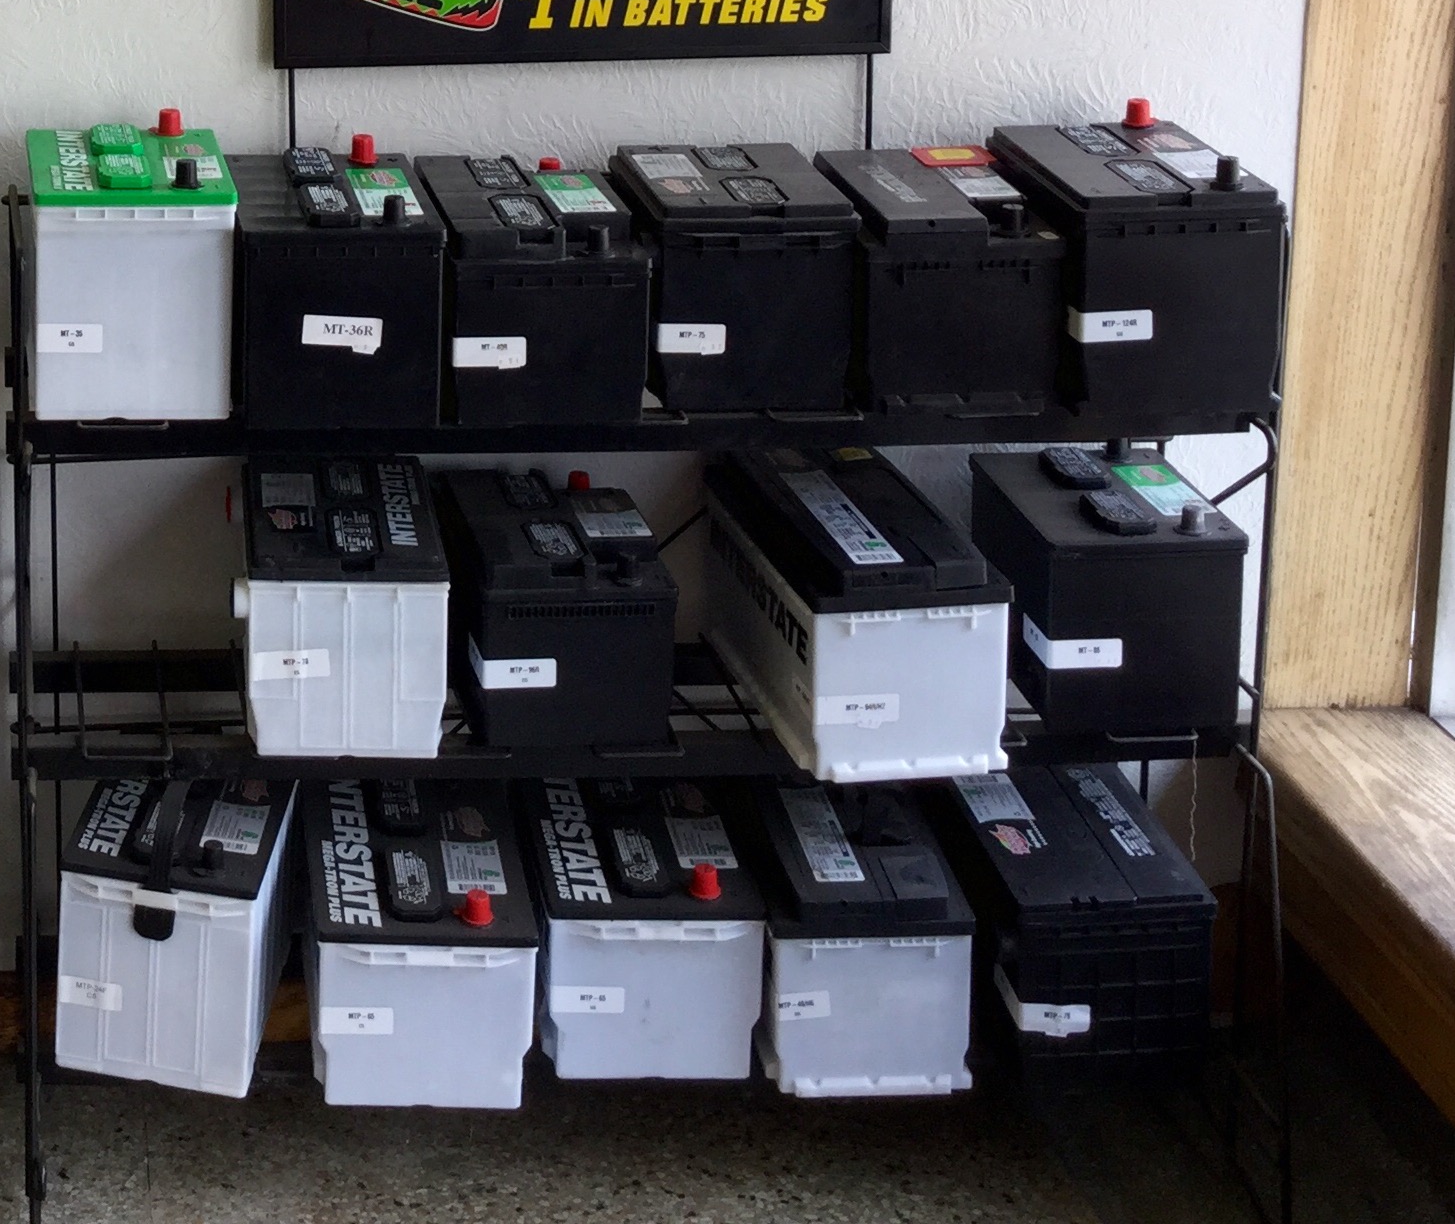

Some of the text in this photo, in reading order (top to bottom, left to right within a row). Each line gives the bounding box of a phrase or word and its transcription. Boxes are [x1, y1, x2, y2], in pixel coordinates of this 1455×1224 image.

[324, 324, 373, 336] MT-36R
[328, 779, 383, 928] NTERSTATE
[543, 777, 613, 904] TERSTATE
[554, 872, 573, 901] PLUS
[328, 896, 343, 923] PLUS
